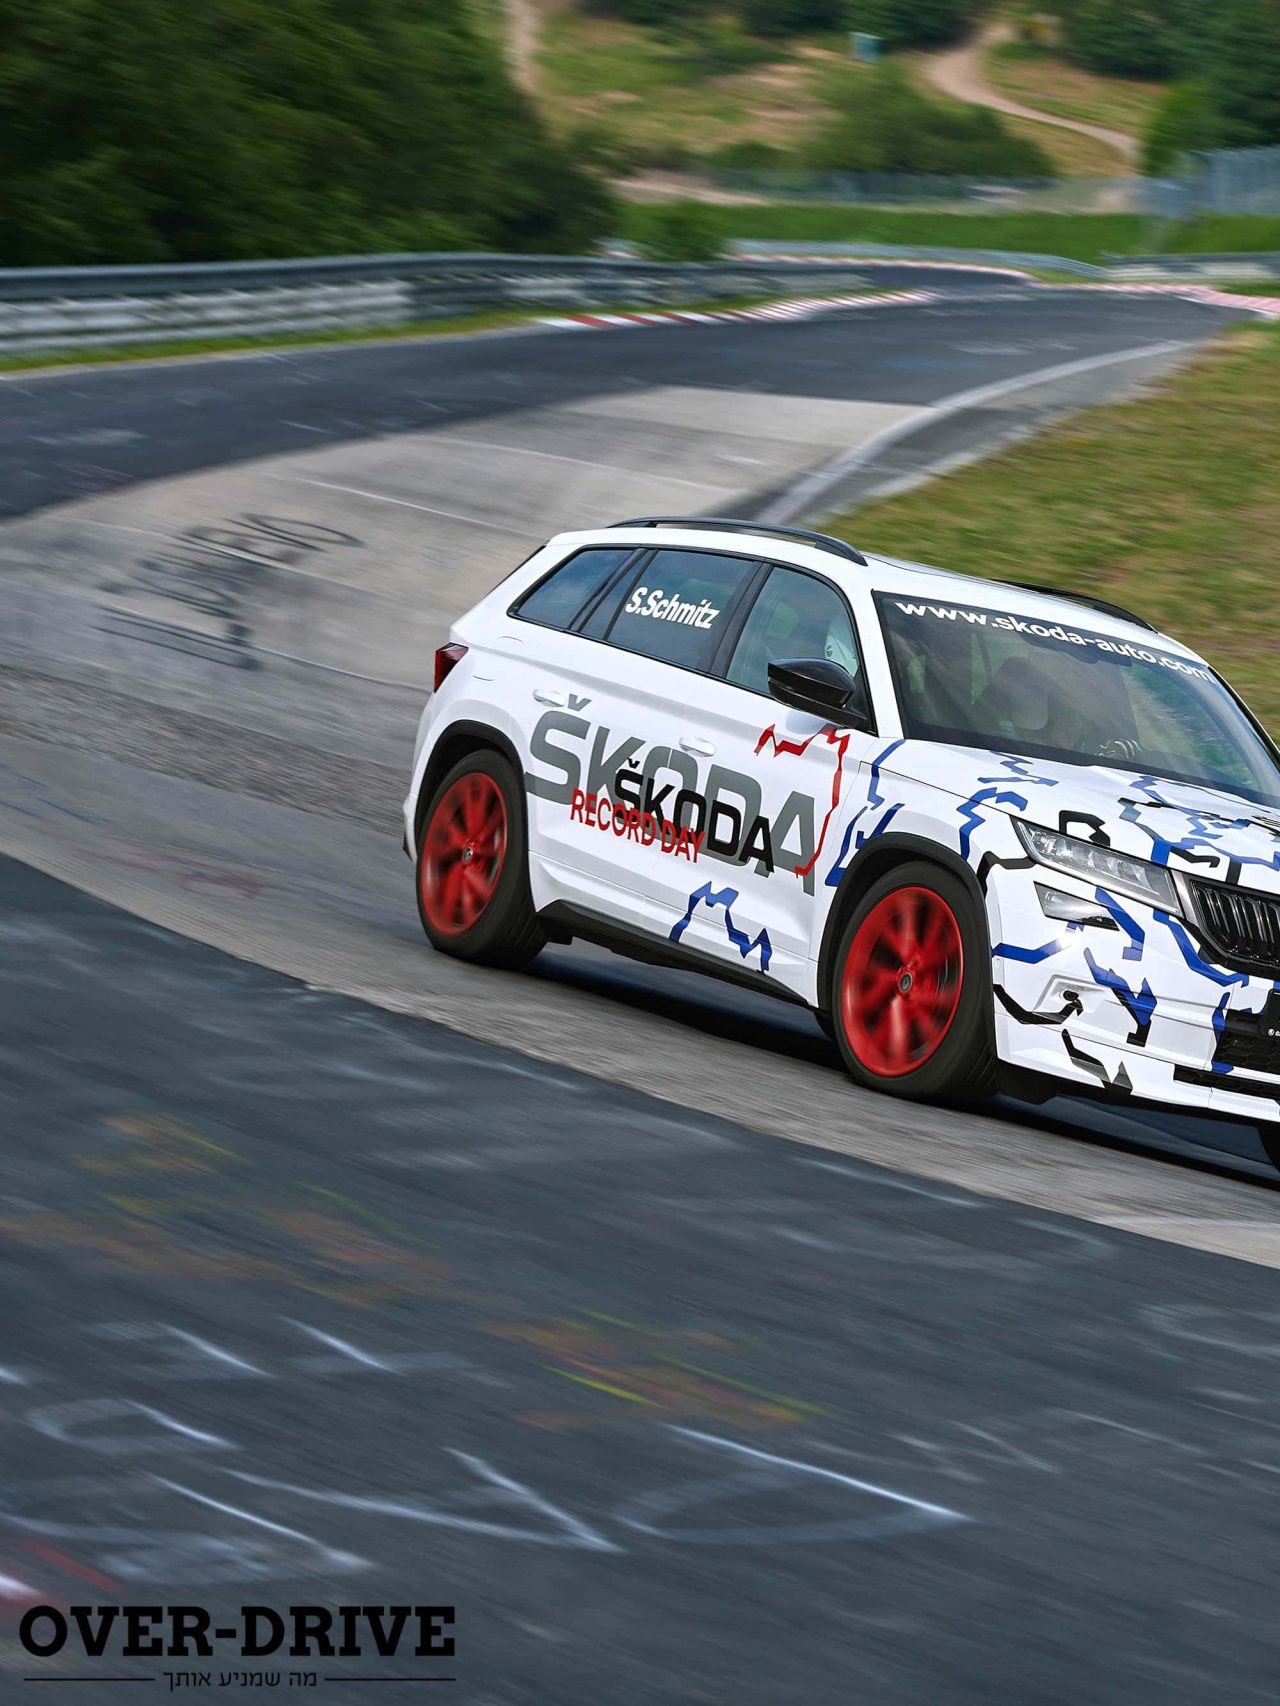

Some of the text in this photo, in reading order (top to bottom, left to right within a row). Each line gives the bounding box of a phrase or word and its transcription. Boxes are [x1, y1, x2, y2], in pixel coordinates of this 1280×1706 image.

[625, 586, 720, 629] S.Schmitz
[894, 602, 1216, 684] www.skoda-auto.com
[523, 693, 815, 897] ŠKODA
[569, 788, 705, 863] RECORD DAY
[615, 757, 774, 873] ŠKODA
